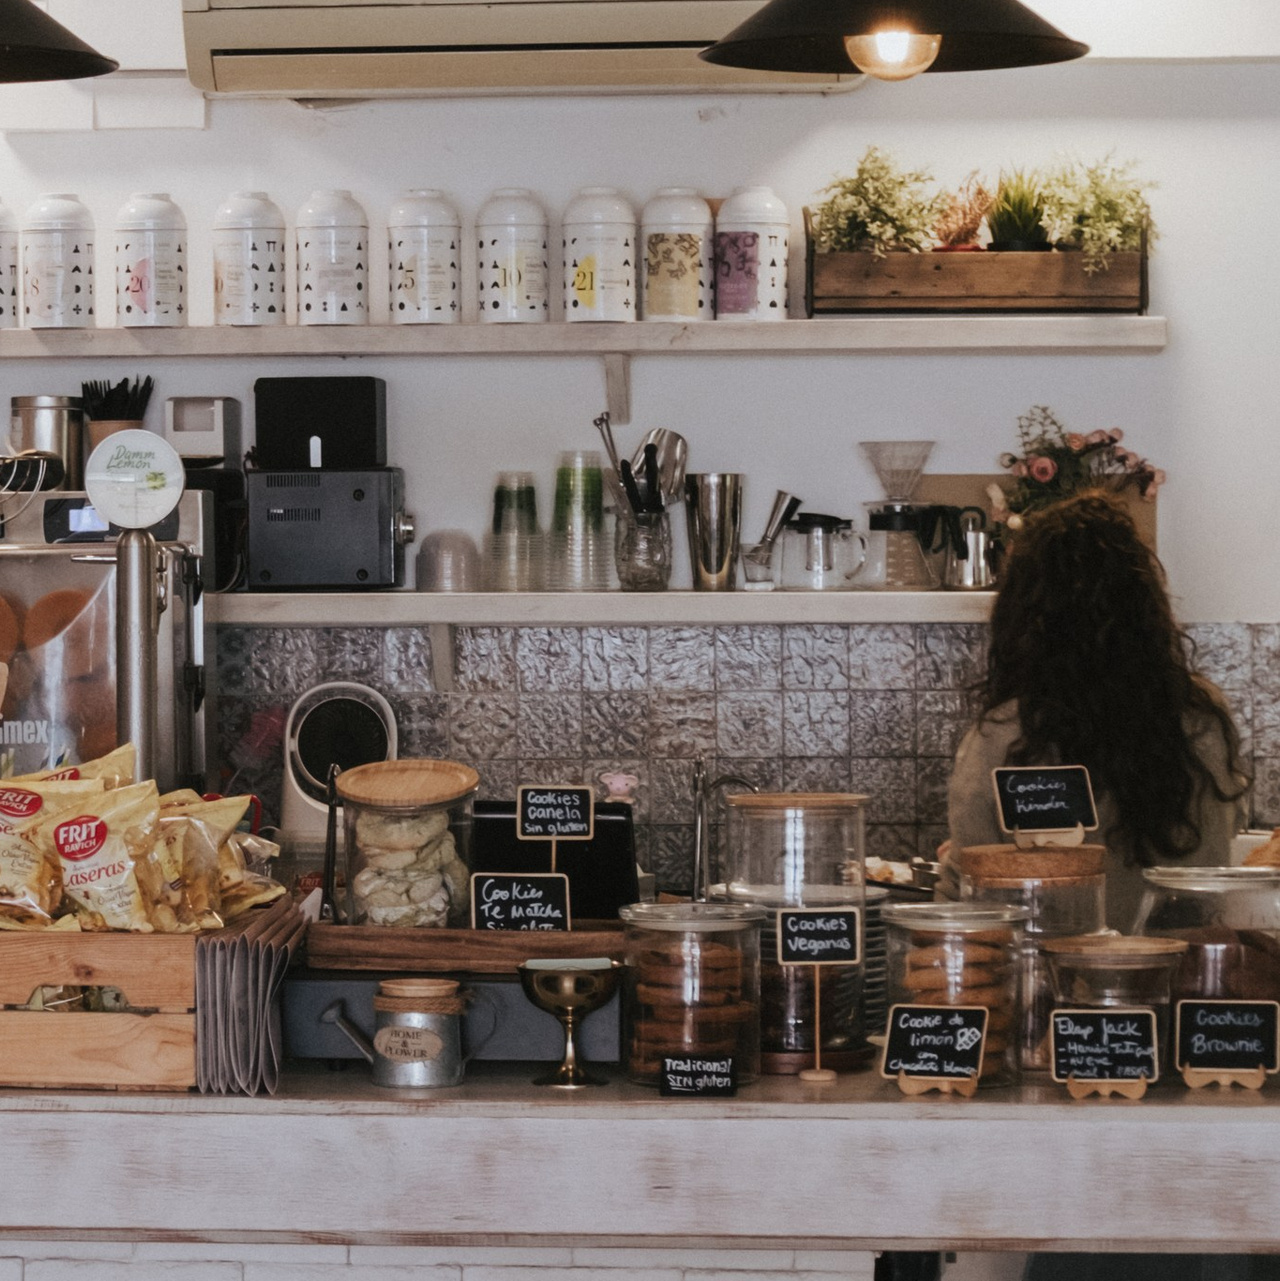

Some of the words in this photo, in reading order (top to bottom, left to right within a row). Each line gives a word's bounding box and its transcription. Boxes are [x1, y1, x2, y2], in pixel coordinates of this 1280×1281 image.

[131, 275, 151, 293] 20
[404, 270, 415, 290] 5
[576, 271, 595, 291] 21
[113, 445, 156, 461] Damm
[106, 455, 151, 469] Lemon
[1007, 775, 1066, 793] Cookies
[527, 791, 580, 805] Cookies
[1016, 795, 1069, 813] Kinder
[59, 820, 101, 845] FRIT
[547, 821, 588, 835] gluten
[64, 838, 96, 853] RAVICH
[482, 878, 543, 902] Cookies
[787, 916, 848, 932] Cookies
[899, 1013, 942, 1028] Cookie
[1196, 1009, 1264, 1027] Cookies
[391, 1030, 422, 1039] HOME
[1191, 1033, 1264, 1054] Brownie
[665, 1058, 732, 1073] Tradicional
[667, 1074, 693, 1087] SIN
[695, 1074, 731, 1090] gluten
